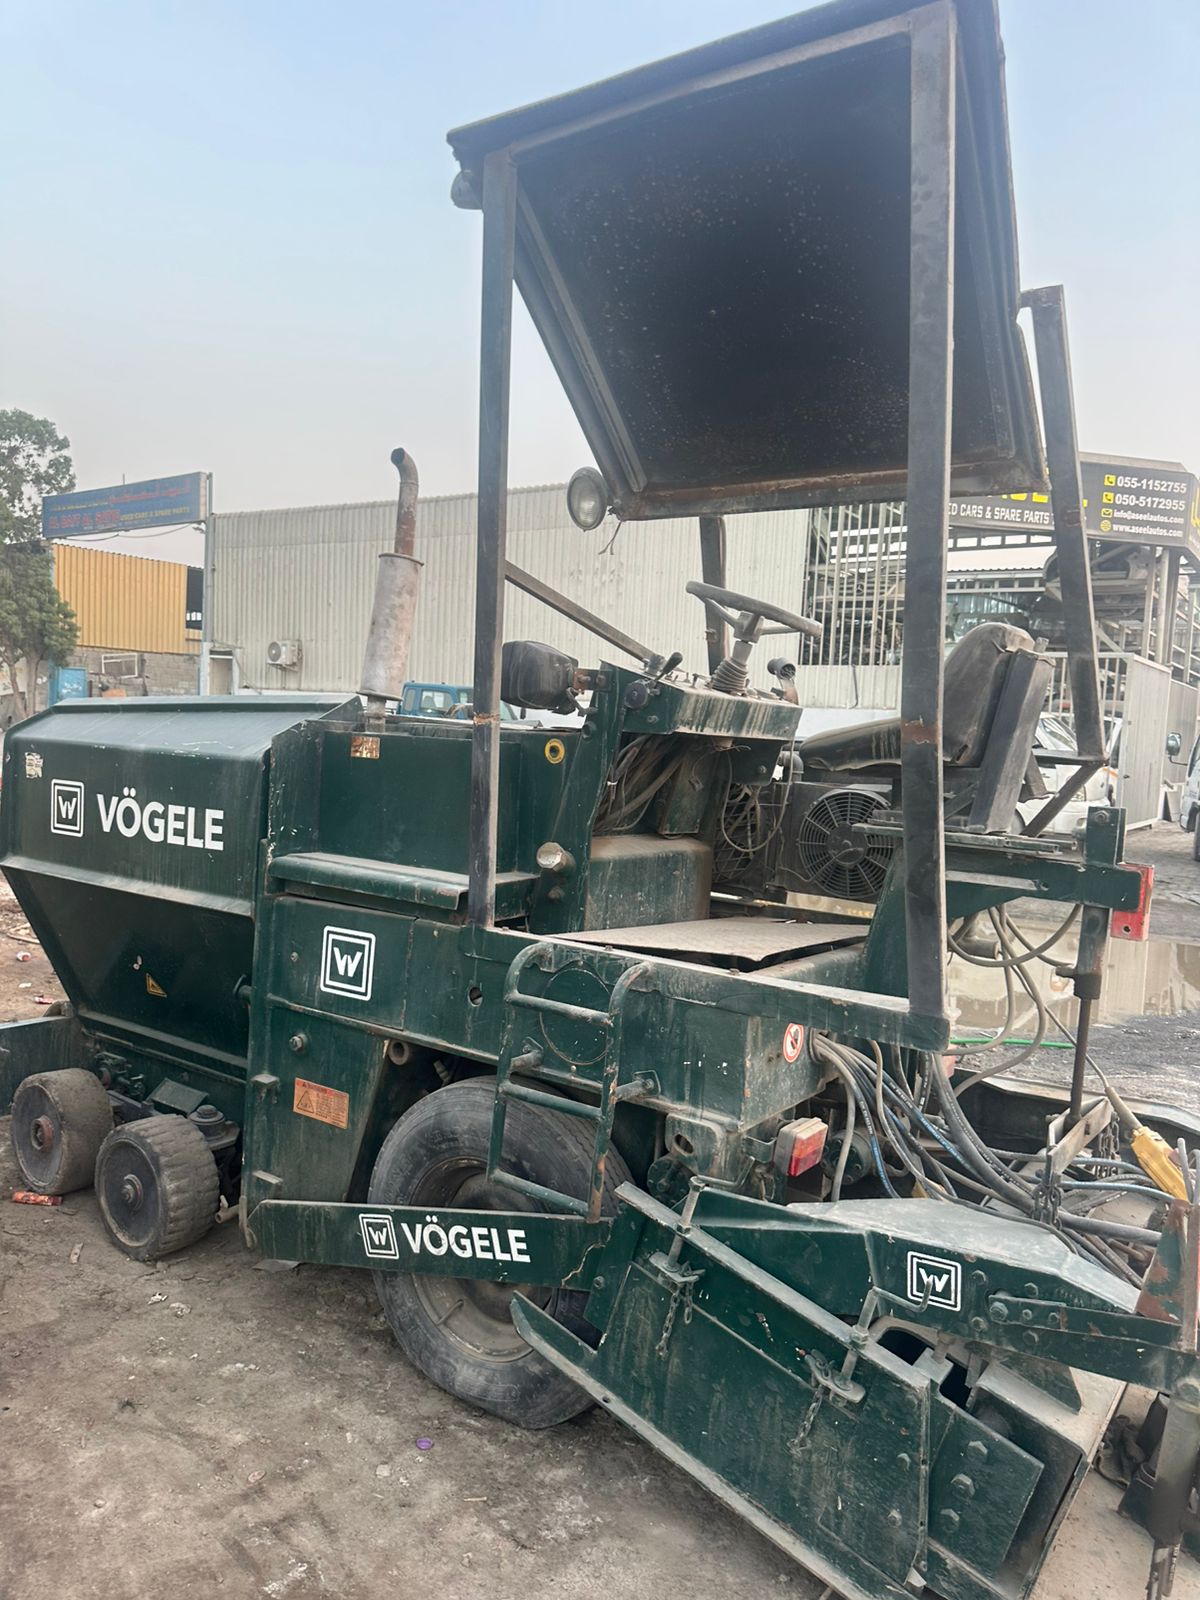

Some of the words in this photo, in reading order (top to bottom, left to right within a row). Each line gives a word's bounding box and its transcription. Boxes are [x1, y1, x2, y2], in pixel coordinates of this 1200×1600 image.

[1117, 476, 1187, 493] 055-1152755
[1115, 493, 1185, 511] 050-5172955
[960, 504, 984, 518] CARS
[985, 506, 992, 519] &
[994, 507, 1022, 522] SPARE
[1023, 510, 1050, 525] PARTS
[96, 786, 224, 851] VÖGELE
[400, 1215, 531, 1263] VÖGELE
